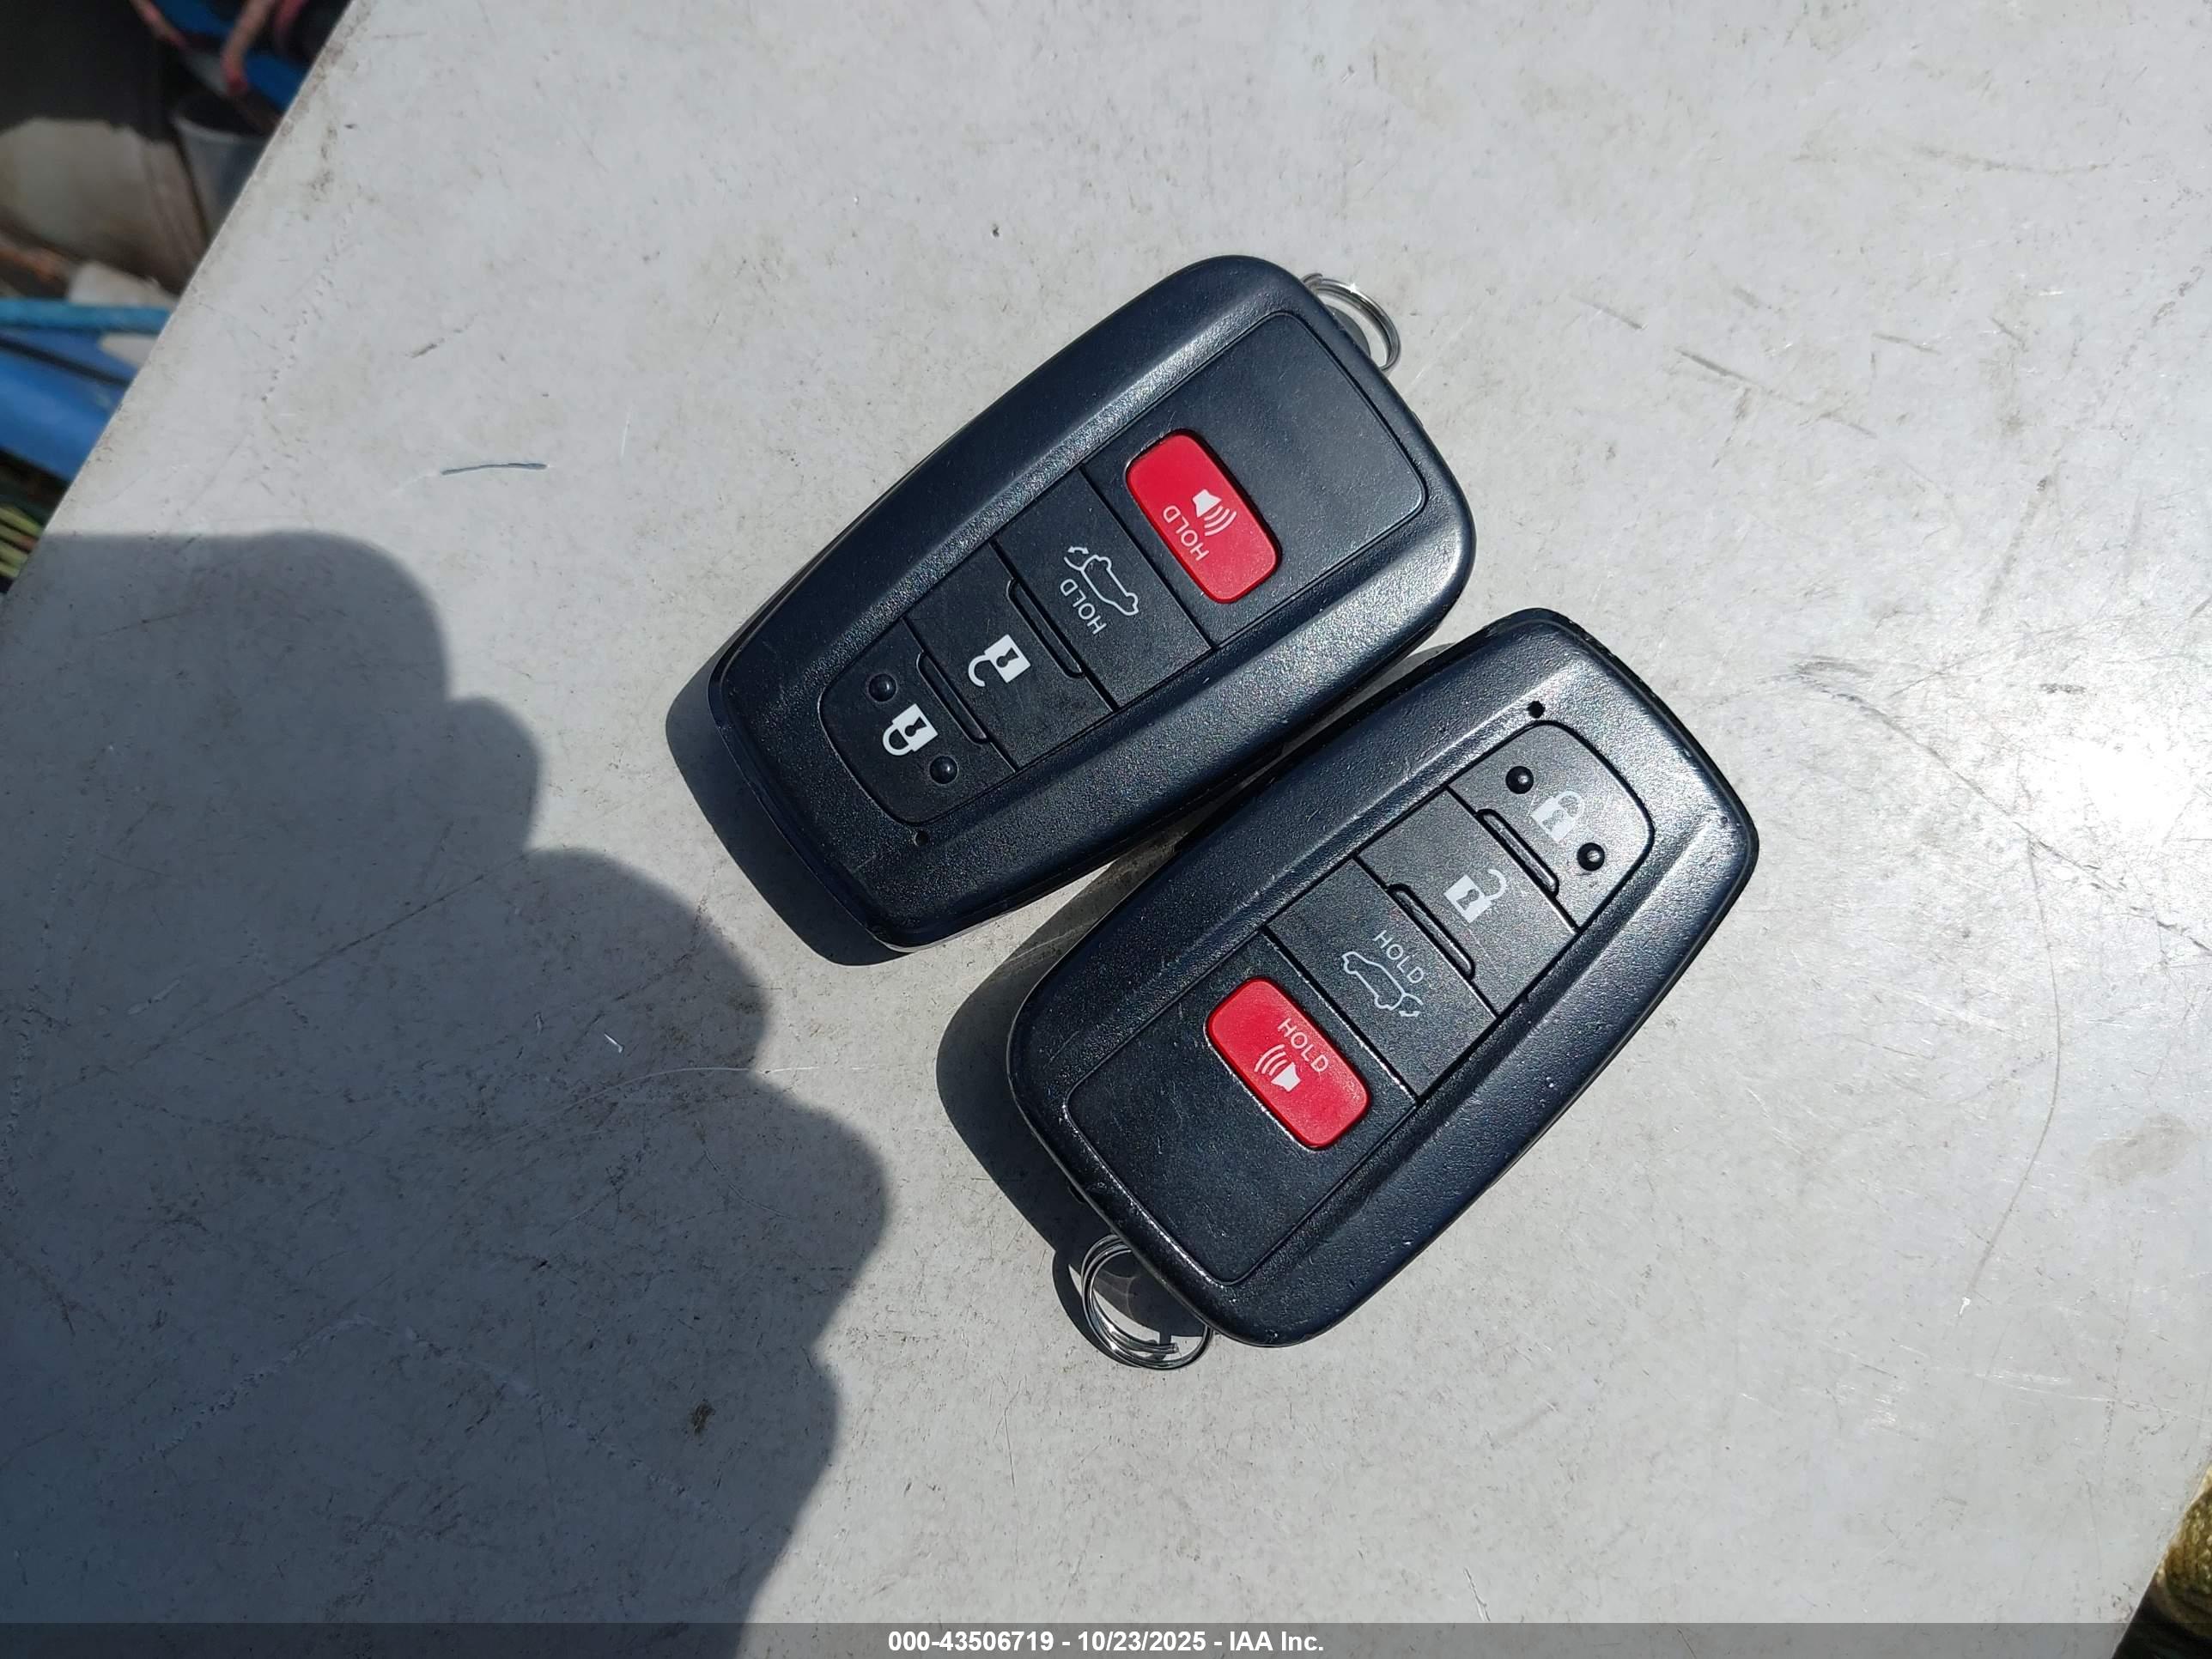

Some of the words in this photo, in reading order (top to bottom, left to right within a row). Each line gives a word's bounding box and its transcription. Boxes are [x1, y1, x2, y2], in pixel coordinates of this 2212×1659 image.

[1163, 505, 1209, 561] HOLD
[1060, 579, 1107, 635] HOLD
[1372, 930, 1424, 983] HOLD
[1277, 1018, 1328, 1072] HOLD
